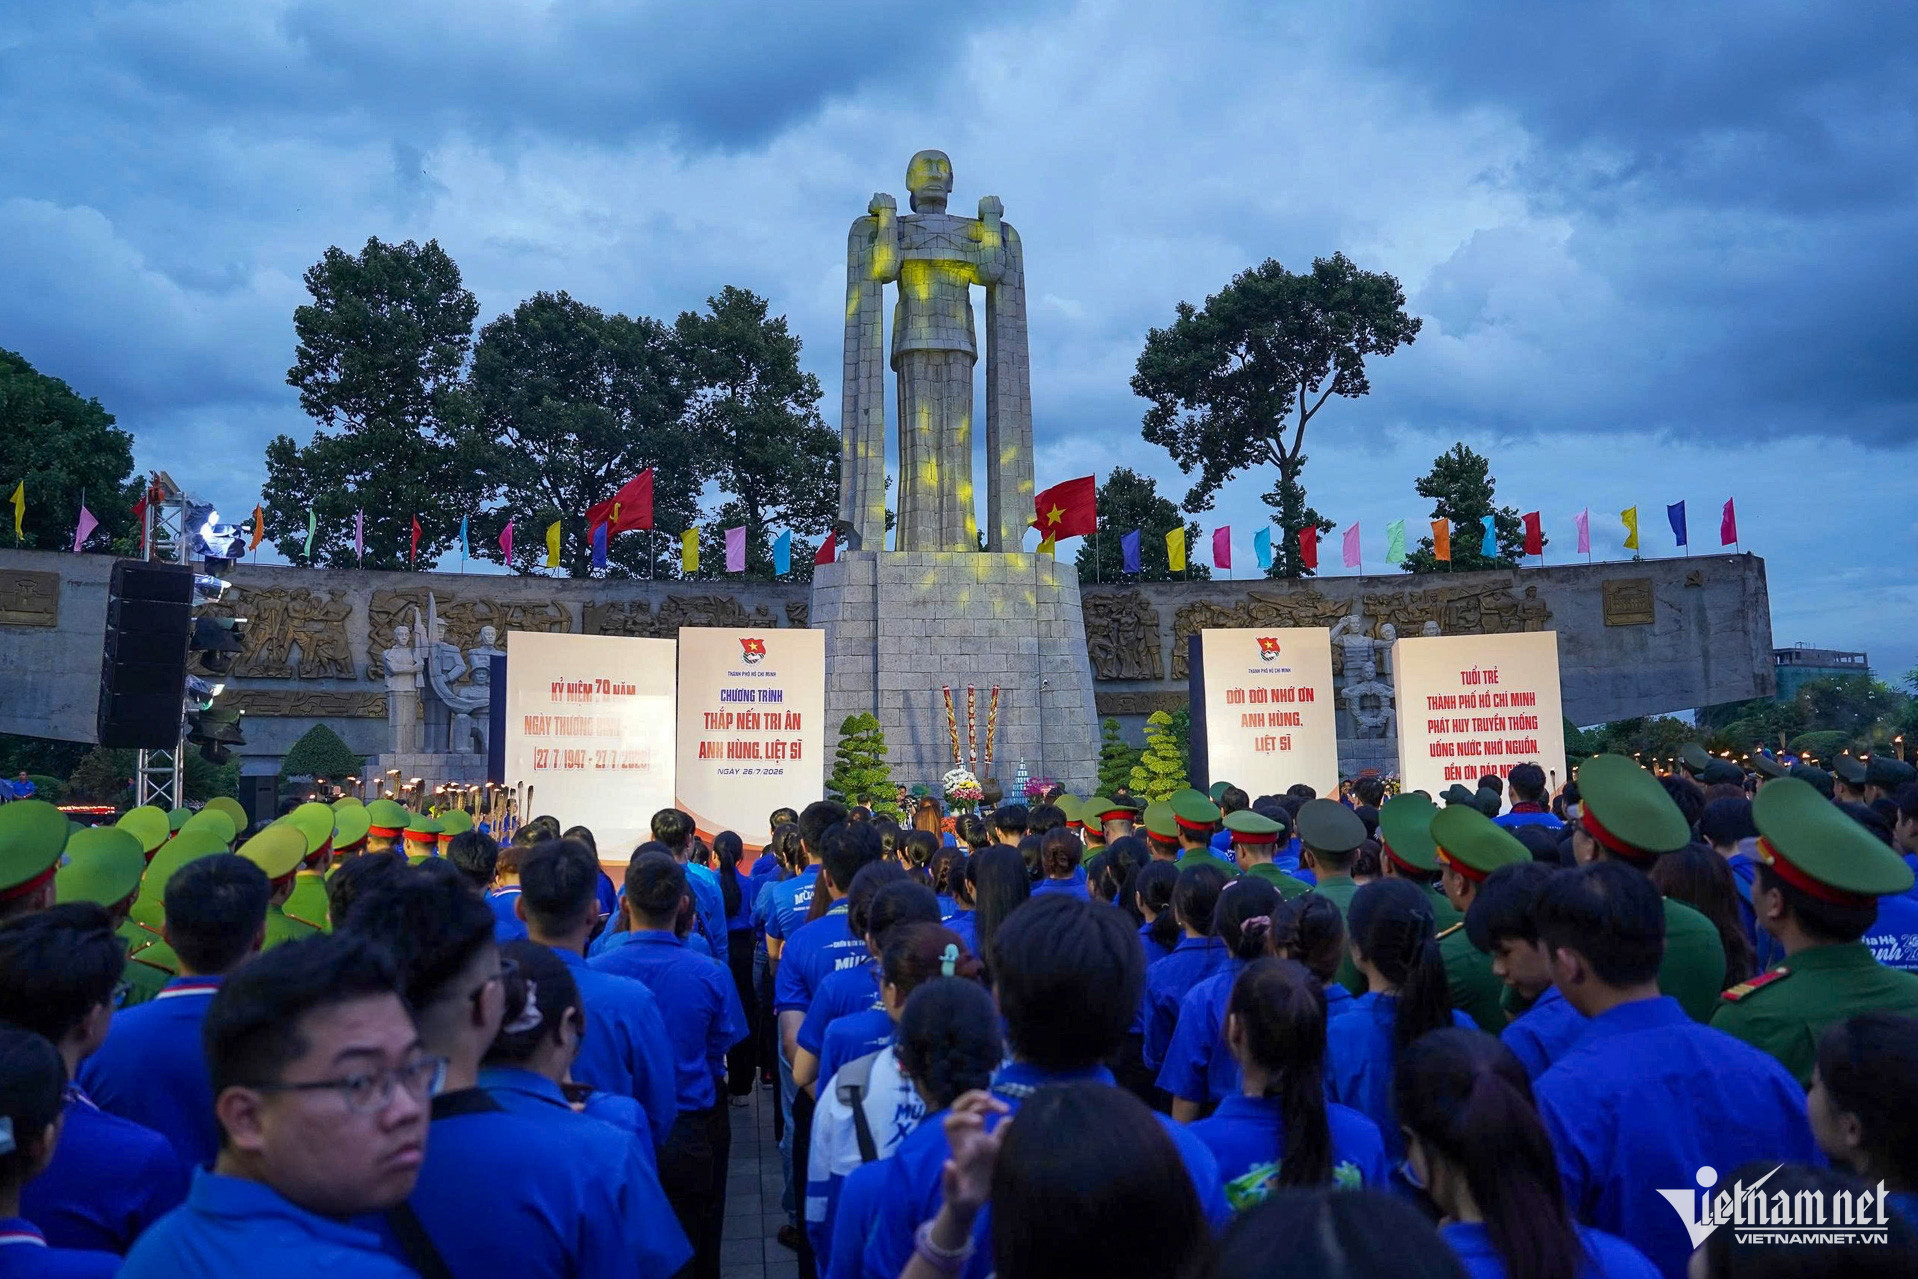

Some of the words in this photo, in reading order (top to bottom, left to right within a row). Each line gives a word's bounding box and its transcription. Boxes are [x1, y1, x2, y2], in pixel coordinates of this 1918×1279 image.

[1460, 664, 1481, 685] TUỔI
[1482, 665, 1499, 685] TRẺ
[567, 679, 592, 706] NIỆM
[720, 687, 755, 702] CHƯƠNG
[758, 687, 783, 702] TRÌNH
[1226, 687, 1245, 704] ĐỜI
[1249, 686, 1268, 703] ĐỜI
[1271, 685, 1295, 703] NHỚ
[1298, 686, 1314, 702] ƠN
[1427, 693, 1456, 710] THÀNH
[1458, 690, 1476, 709] PHỐ
[1479, 689, 1491, 708] HỒ
[1493, 690, 1508, 708] CHÍ
[1510, 692, 1536, 707] MINH
[524, 712, 551, 736] NGÀY
[703, 706, 734, 730] THẮP
[736, 707, 760, 730] NẾN
[764, 712, 781, 730] TRI
[784, 710, 801, 730] ÂN
[1241, 713, 1265, 728] ANH
[1428, 717, 1450, 733] PHÁT
[1452, 718, 1470, 733] HUY
[1472, 713, 1506, 732] TRUYỀN
[1508, 712, 1538, 731] THỐNG
[698, 741, 724, 759] ANH
[765, 738, 787, 763] LIỆT
[790, 738, 802, 759] SĨ
[1255, 734, 1276, 754] LIỆT
[1279, 733, 1291, 751] SĨ
[1429, 738, 1454, 757] UỐNG
[1456, 739, 1482, 756] NƯỚC
[1484, 738, 1504, 755] NHỚ
[1444, 762, 1462, 780] ĐỀN
[1464, 764, 1477, 780] ƠN
